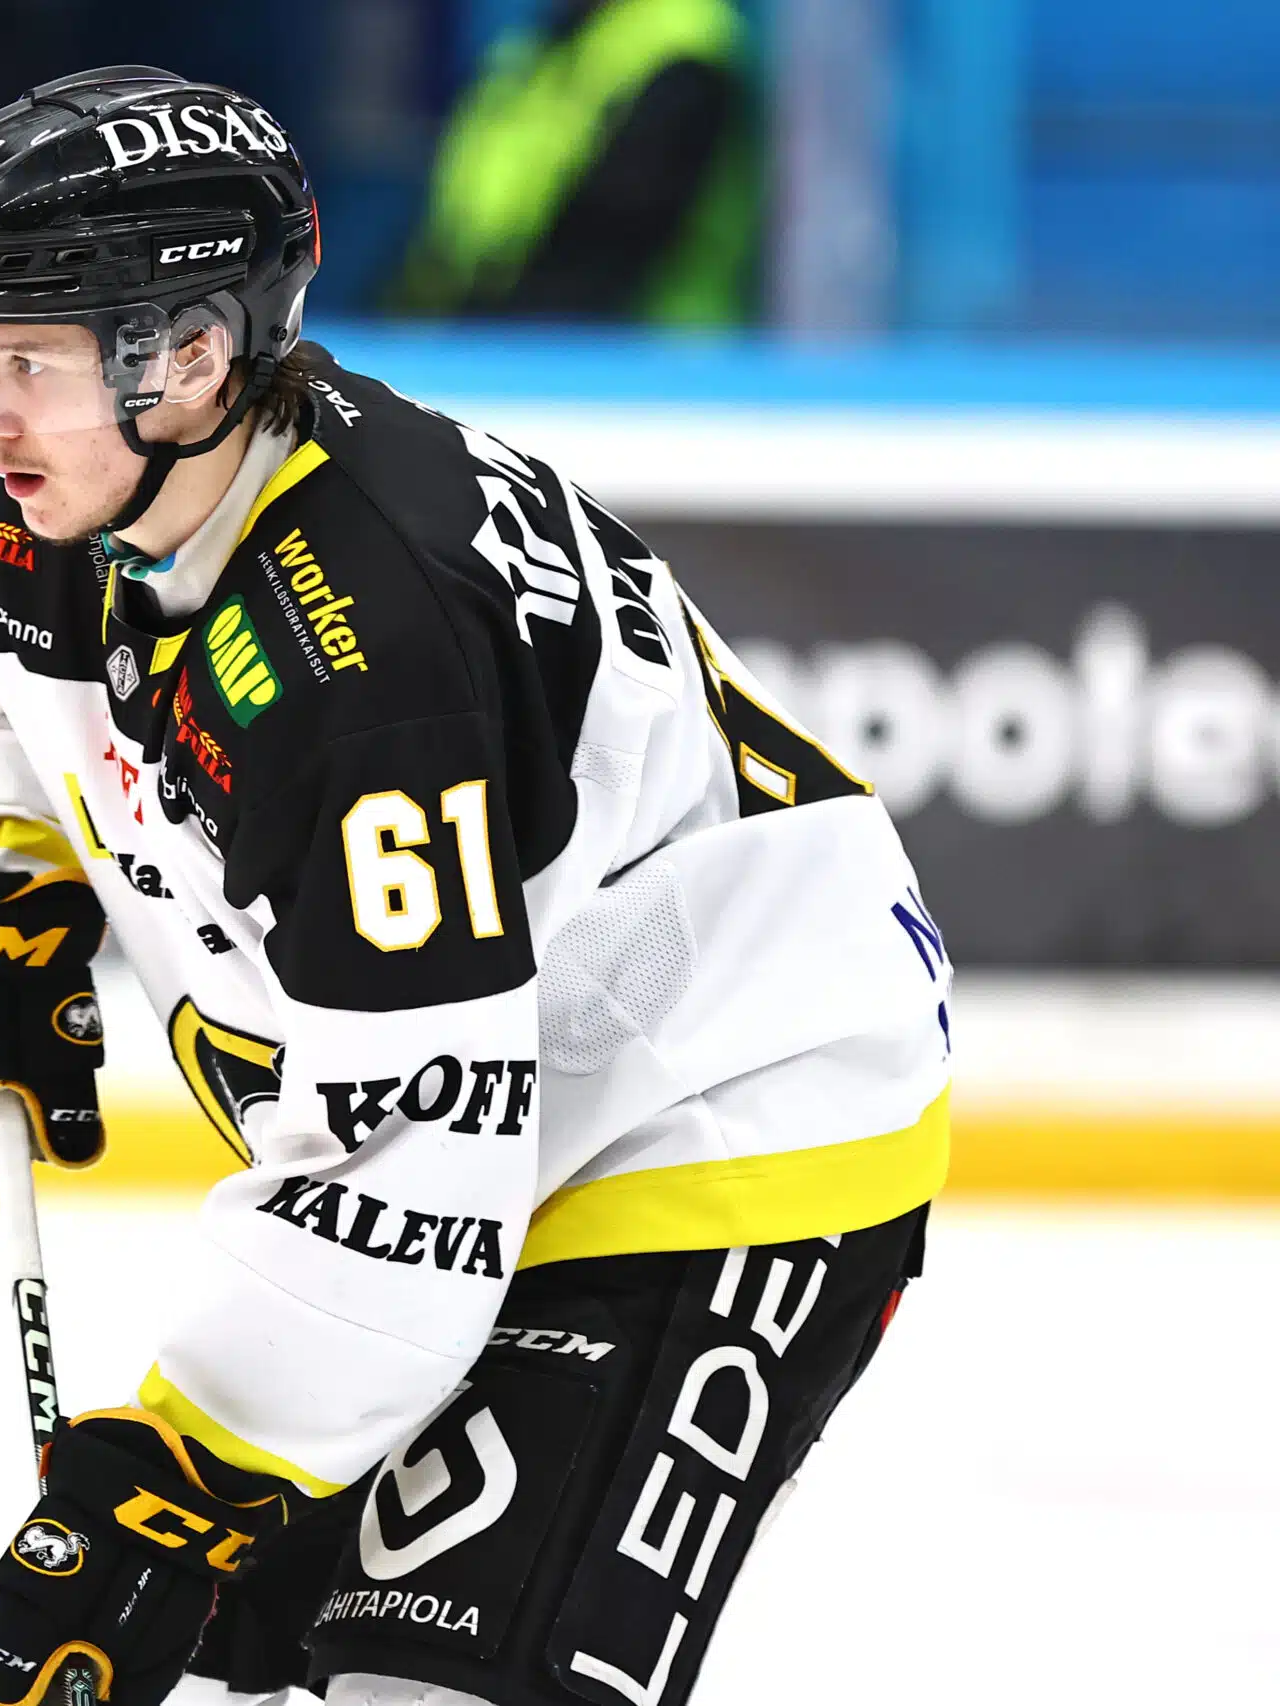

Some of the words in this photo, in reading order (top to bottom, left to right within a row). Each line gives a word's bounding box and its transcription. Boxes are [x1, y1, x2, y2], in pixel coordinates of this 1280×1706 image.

[97, 102, 287, 171] DISAS
[159, 236, 244, 264] CCM
[124, 395, 161, 409] CCM
[308, 376, 363, 428] TAC
[274, 527, 368, 672] worker
[341, 779, 504, 952] 61
[50, 1108, 99, 1122] CC
[317, 1054, 537, 1153] KOFF
[256, 1174, 505, 1280] KALEVA
[18, 1279, 56, 1434] CCM
[487, 1327, 616, 1362] CCM
[569, 1234, 842, 1706] LEDE
[113, 1485, 256, 1572] CC
